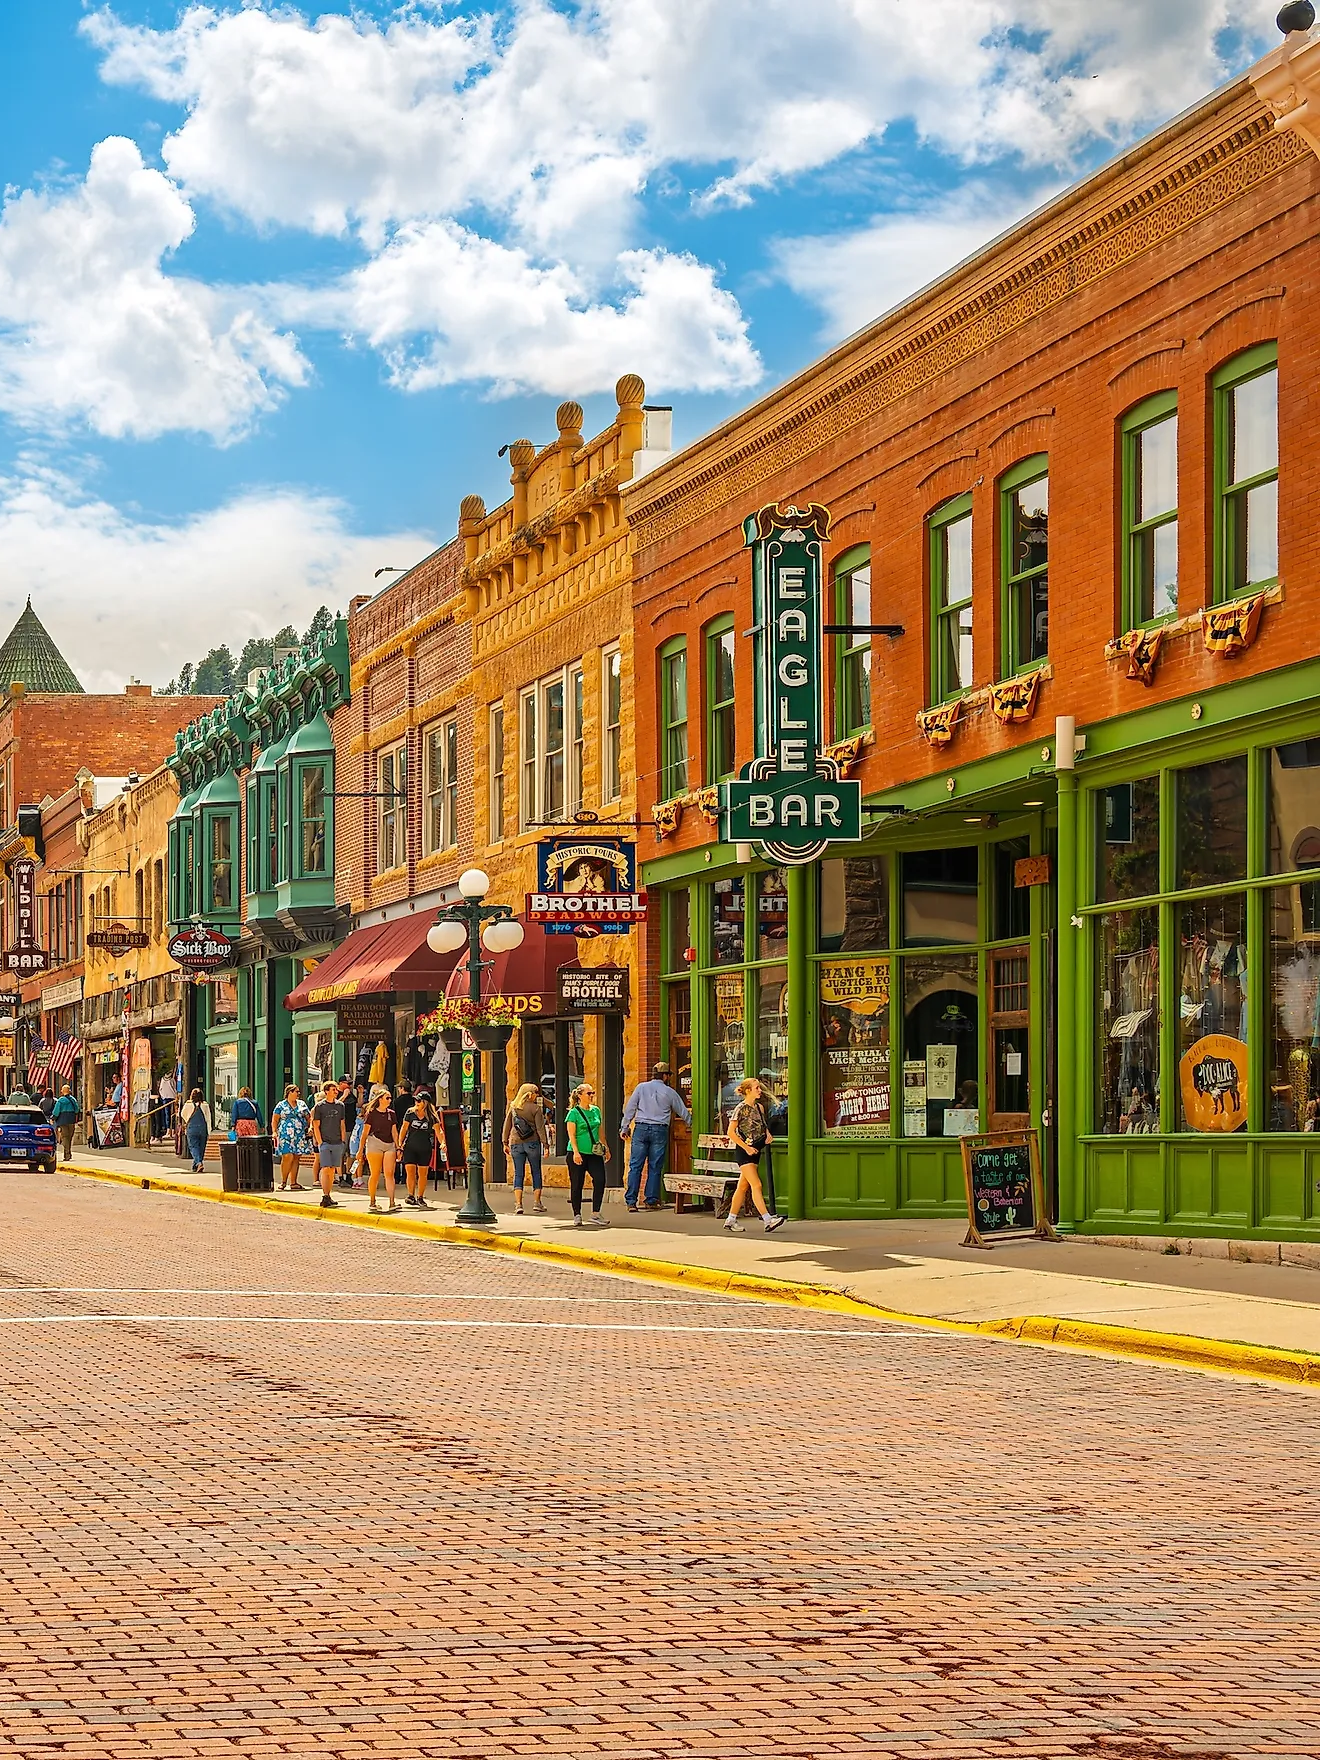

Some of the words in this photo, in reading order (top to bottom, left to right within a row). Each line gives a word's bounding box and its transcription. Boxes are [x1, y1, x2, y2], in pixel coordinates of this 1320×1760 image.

[778, 567, 808, 772] EAGLE
[749, 794, 842, 827] BAR
[555, 847, 592, 861] HISTORIC
[593, 847, 618, 860] TOURS
[19, 864, 31, 905] WILD
[530, 894, 647, 912] BROTHEL
[530, 911, 646, 920] DEADWOOD
[19, 908, 31, 948] BILL
[603, 923, 624, 931] 1980
[93, 934, 123, 944] TRADING
[125, 934, 143, 944] POST
[170, 939, 203, 957] Sick
[203, 940, 231, 958] Boy
[8, 954, 44, 968] BAR
[821, 966, 865, 980] HANG
[825, 977, 873, 988] JUSTICE
[876, 976, 889, 985] FO
[562, 986, 623, 998] BROTHEL
[833, 986, 862, 996] WILD
[828, 1051, 849, 1059] THE
[851, 1049, 882, 1057] TRIAL
[829, 1057, 856, 1065] JACK
[858, 1056, 890, 1064] McCAL
[835, 1089, 858, 1101] SHOW
[859, 1085, 890, 1098] TONIGHT
[840, 1097, 863, 1116] RIGHT
[866, 1093, 889, 1113] HERE!
[1004, 1152, 1018, 1168] get
[981, 1170, 1004, 1183] taste
